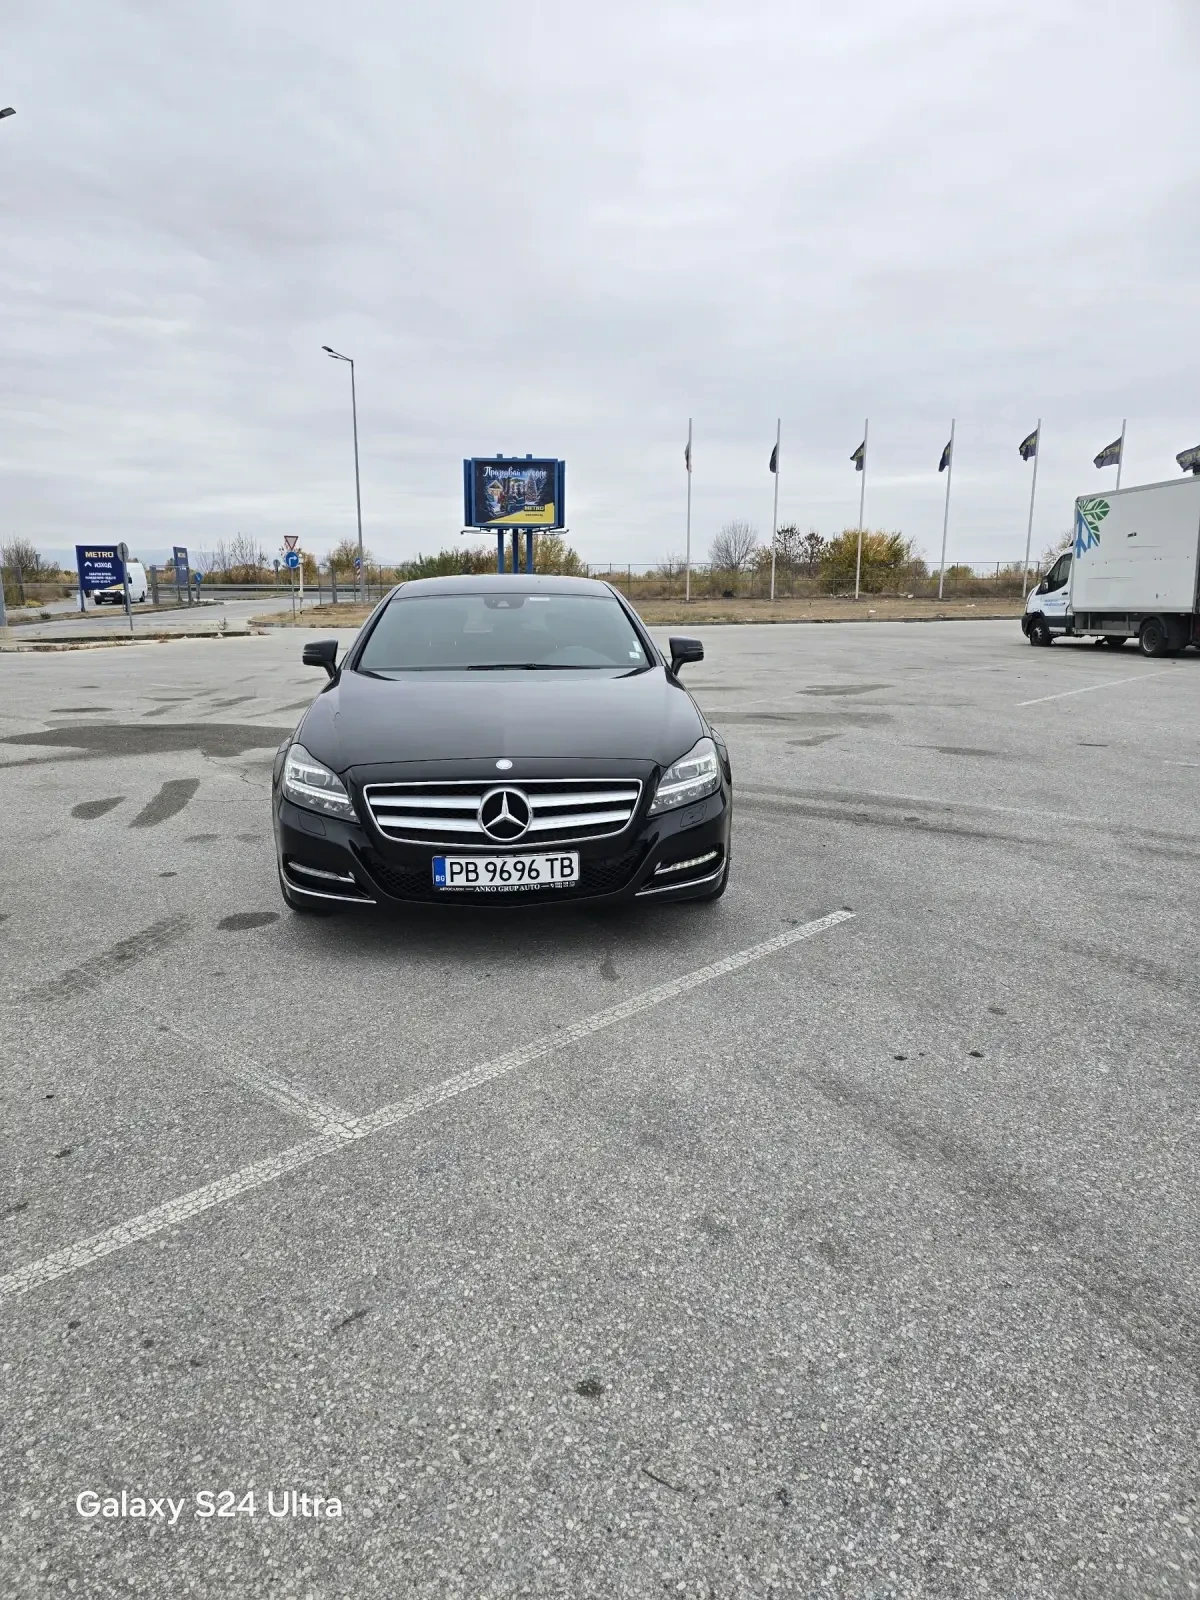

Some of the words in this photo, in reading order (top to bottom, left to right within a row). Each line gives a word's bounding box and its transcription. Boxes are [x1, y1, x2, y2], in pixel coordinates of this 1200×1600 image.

[449, 862, 479, 882] PB
[484, 860, 540, 881] 9696
[545, 857, 574, 878] TB
